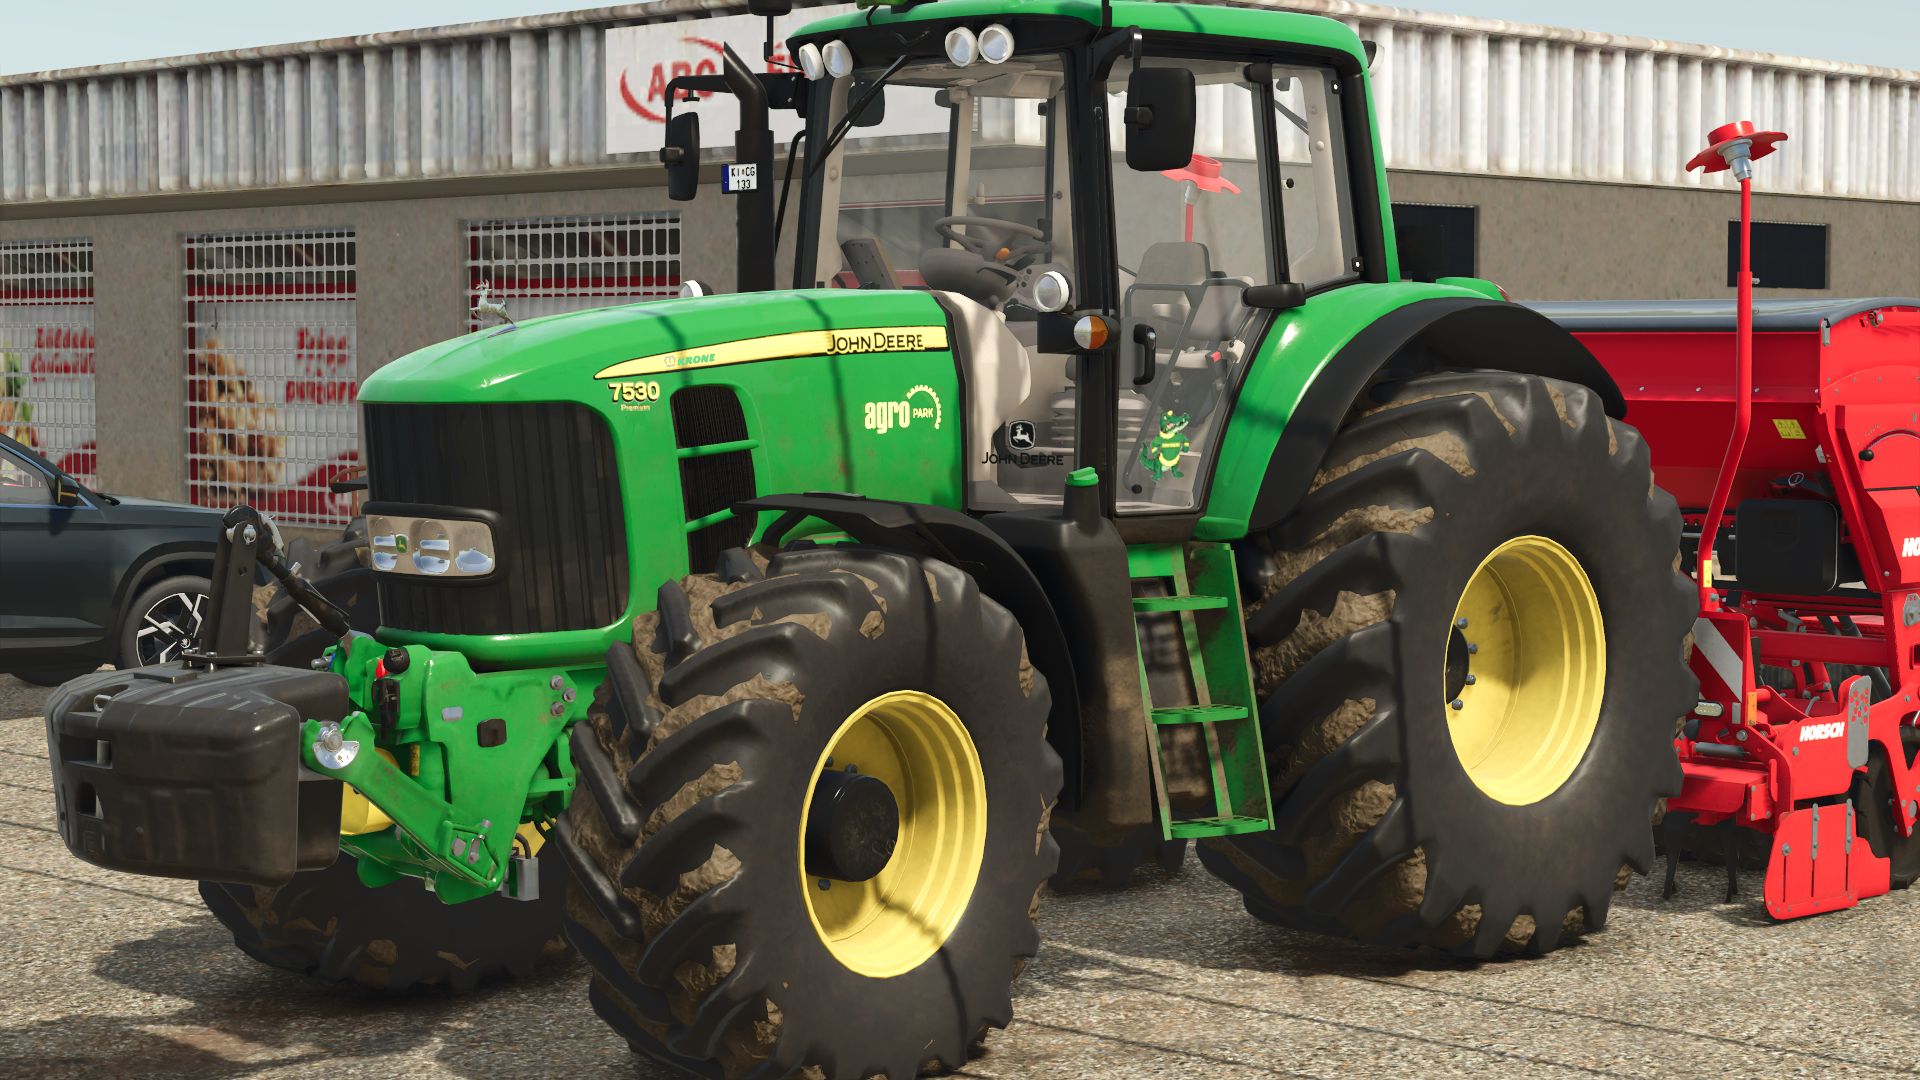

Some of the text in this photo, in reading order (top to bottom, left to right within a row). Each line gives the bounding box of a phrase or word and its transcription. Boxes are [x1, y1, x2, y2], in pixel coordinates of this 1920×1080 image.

[737, 179, 751, 190] 133
[827, 332, 924, 352] JOHN DEERE
[677, 353, 716, 366] KRONE
[607, 381, 660, 402] 7530
[864, 401, 934, 434] agro PARK
[981, 452, 1064, 465] JOHN DEERE
[1799, 721, 1845, 742] HORSCH
